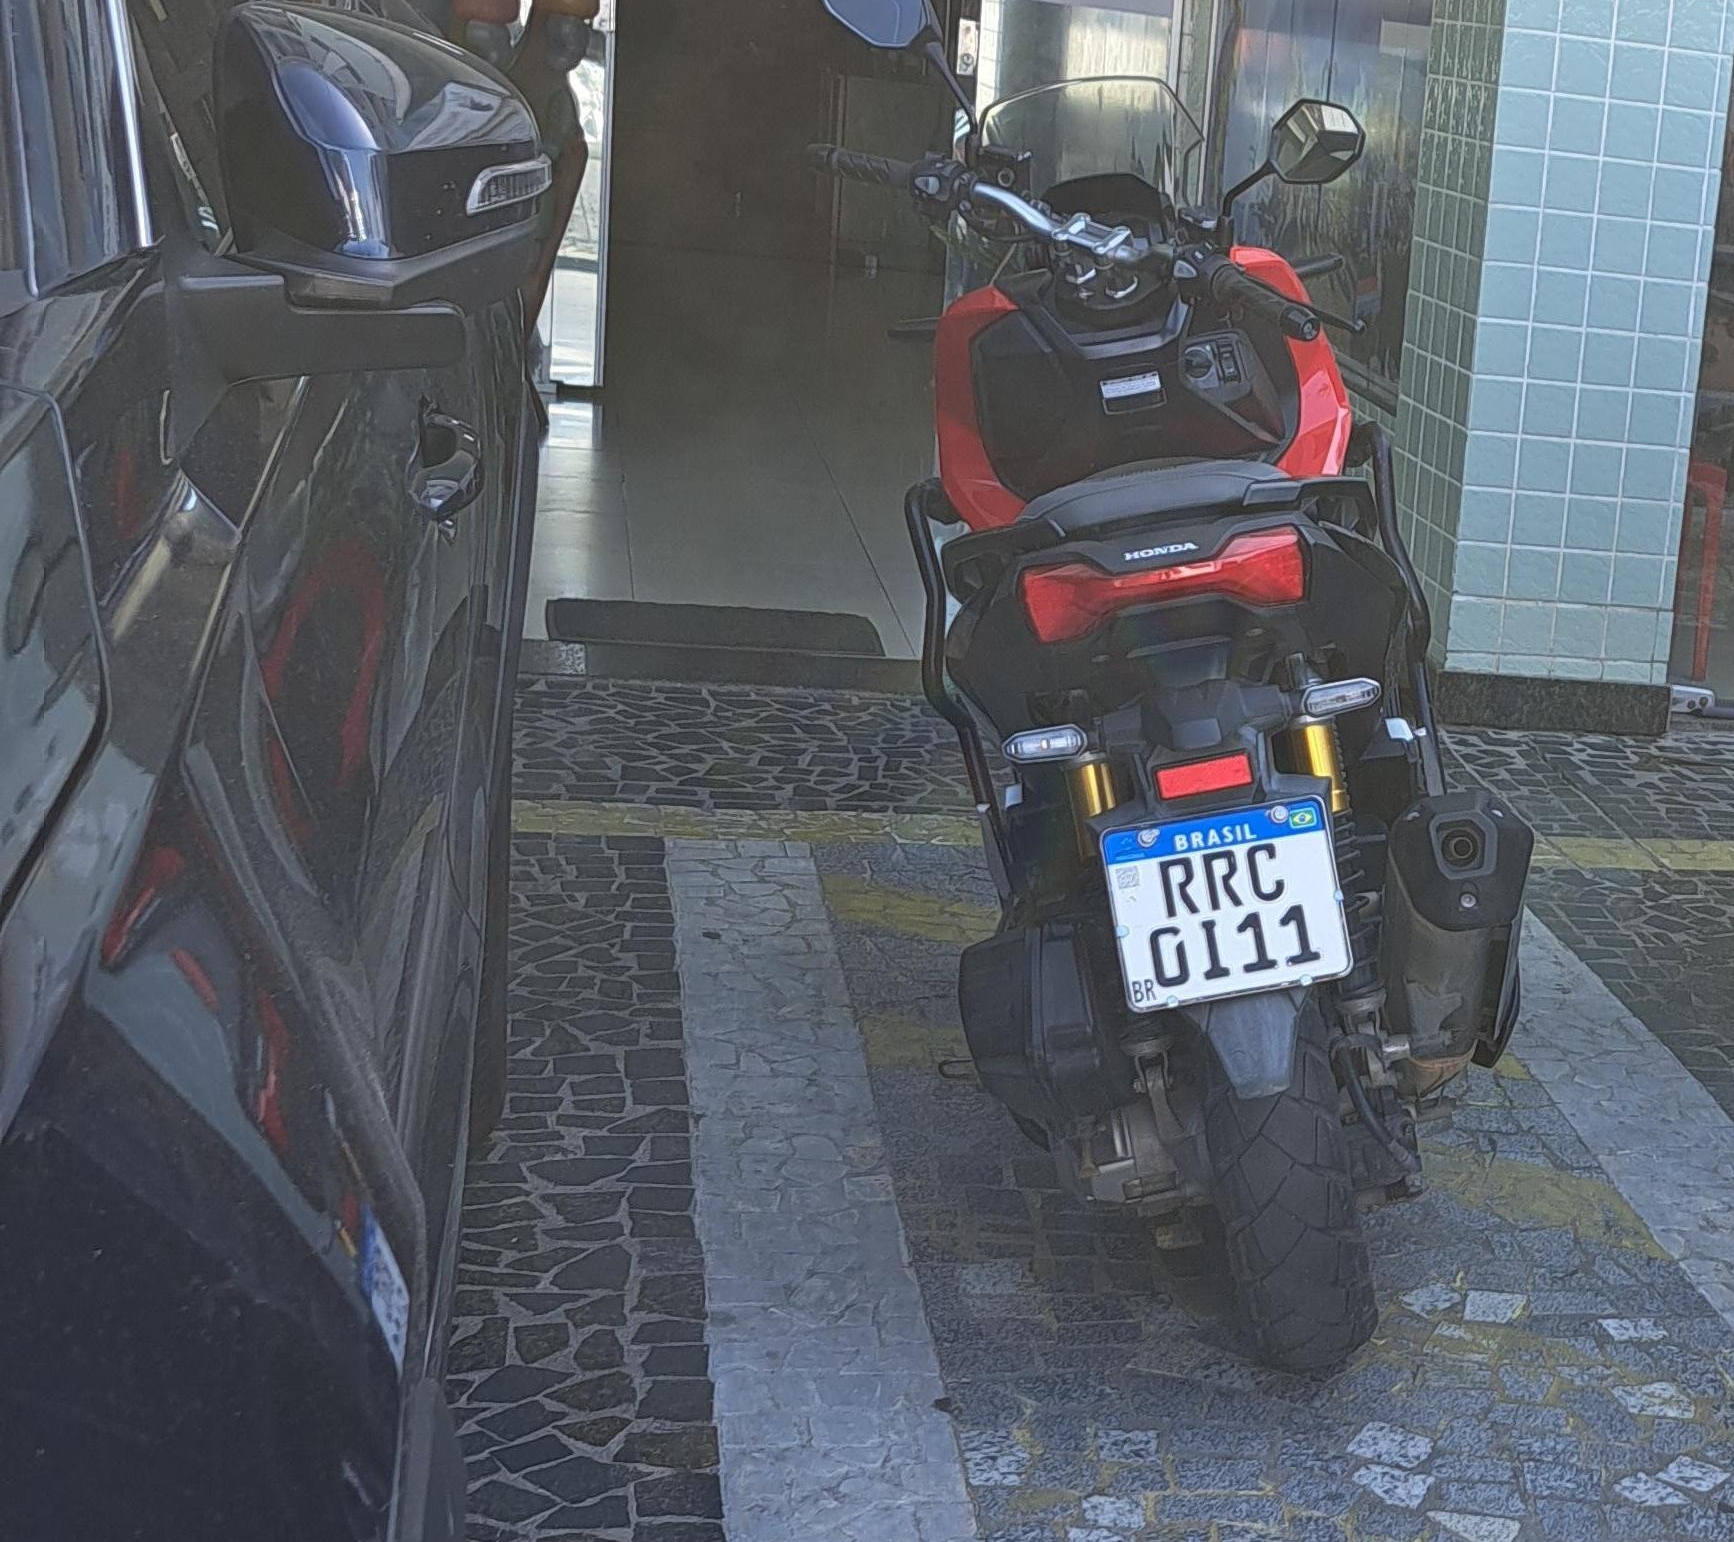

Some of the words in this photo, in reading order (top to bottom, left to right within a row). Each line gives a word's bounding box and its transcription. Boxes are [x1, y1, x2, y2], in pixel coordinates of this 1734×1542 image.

[1124, 542, 1199, 561] HONDA
[1173, 823, 1257, 852] BRASIL
[1159, 843, 1285, 917] RRC
[1132, 979, 1156, 1003] BR
